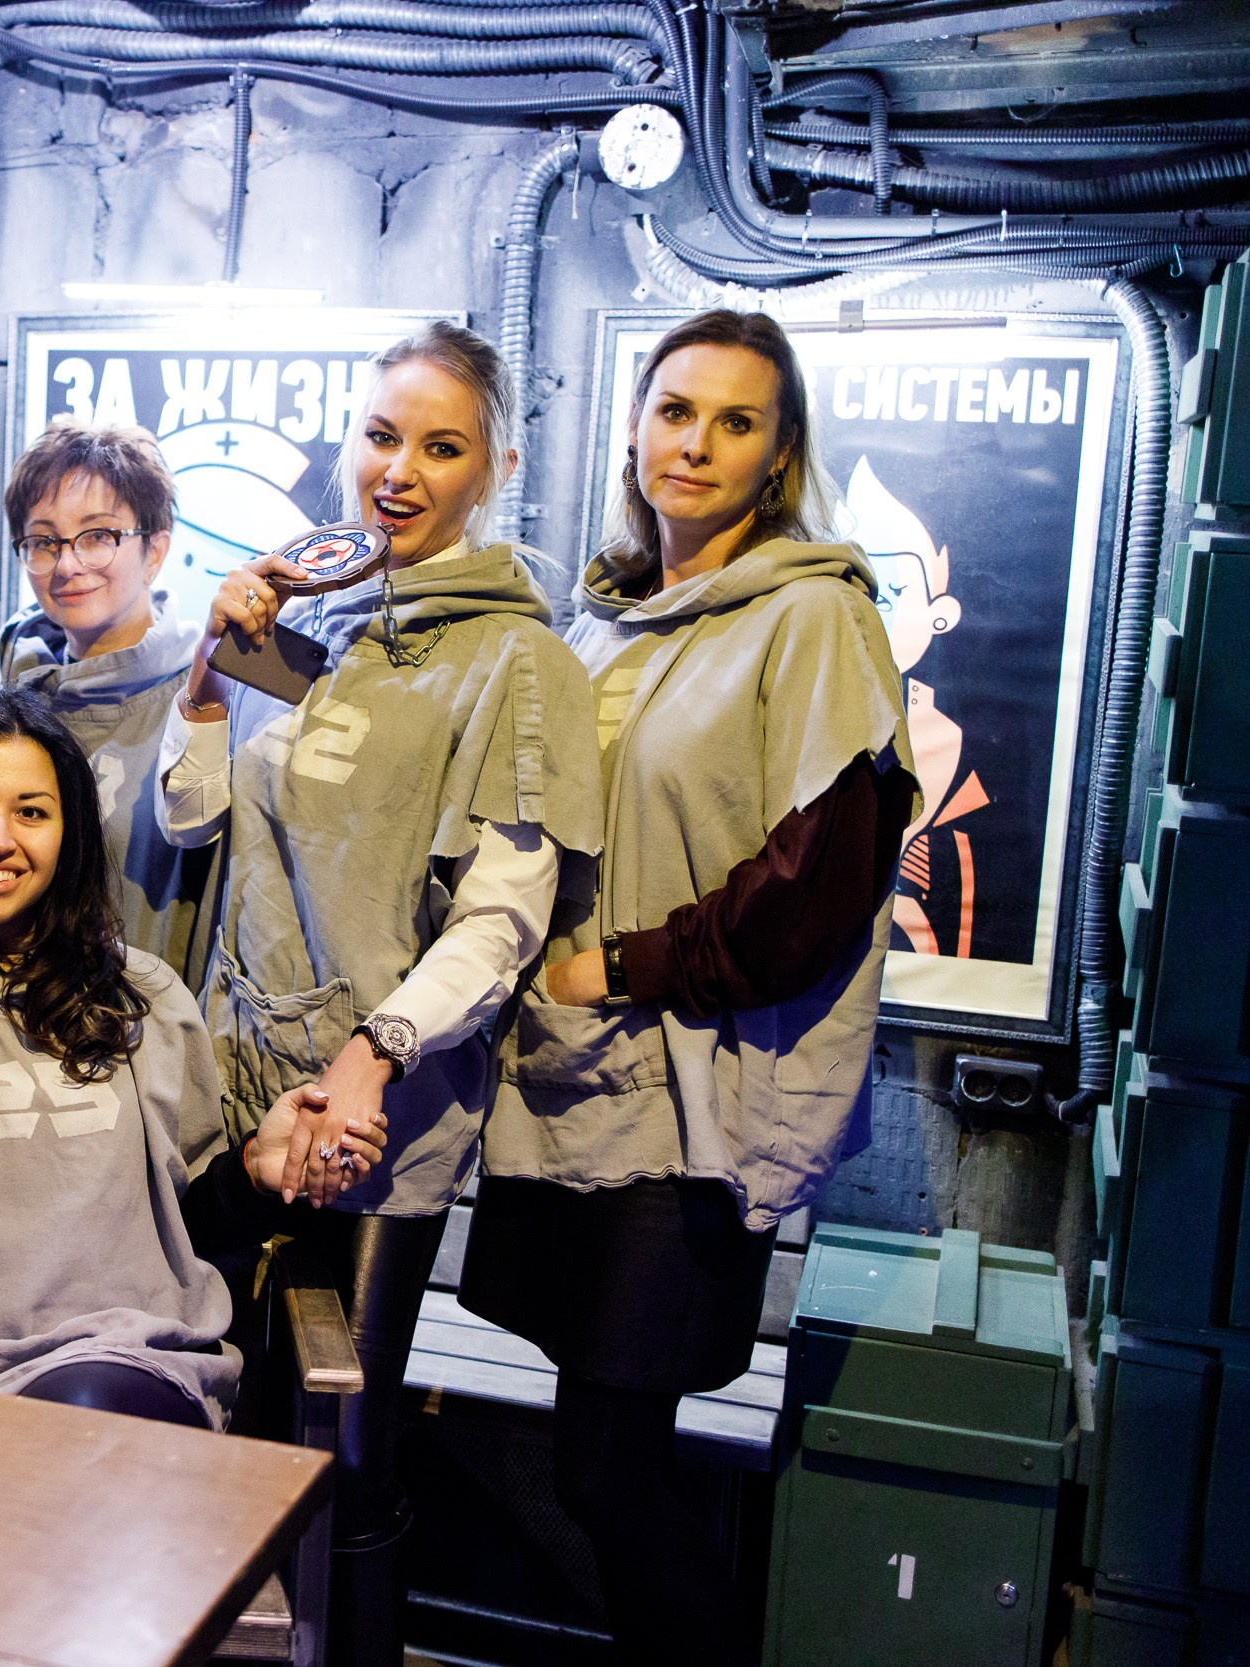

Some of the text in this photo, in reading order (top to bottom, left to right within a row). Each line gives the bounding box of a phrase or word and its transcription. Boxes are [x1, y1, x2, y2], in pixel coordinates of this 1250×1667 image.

[53, 357, 138, 428] ЗА
[833, 366, 1079, 424] СИСТЕМЫ
[887, 1553, 916, 1600] 1
